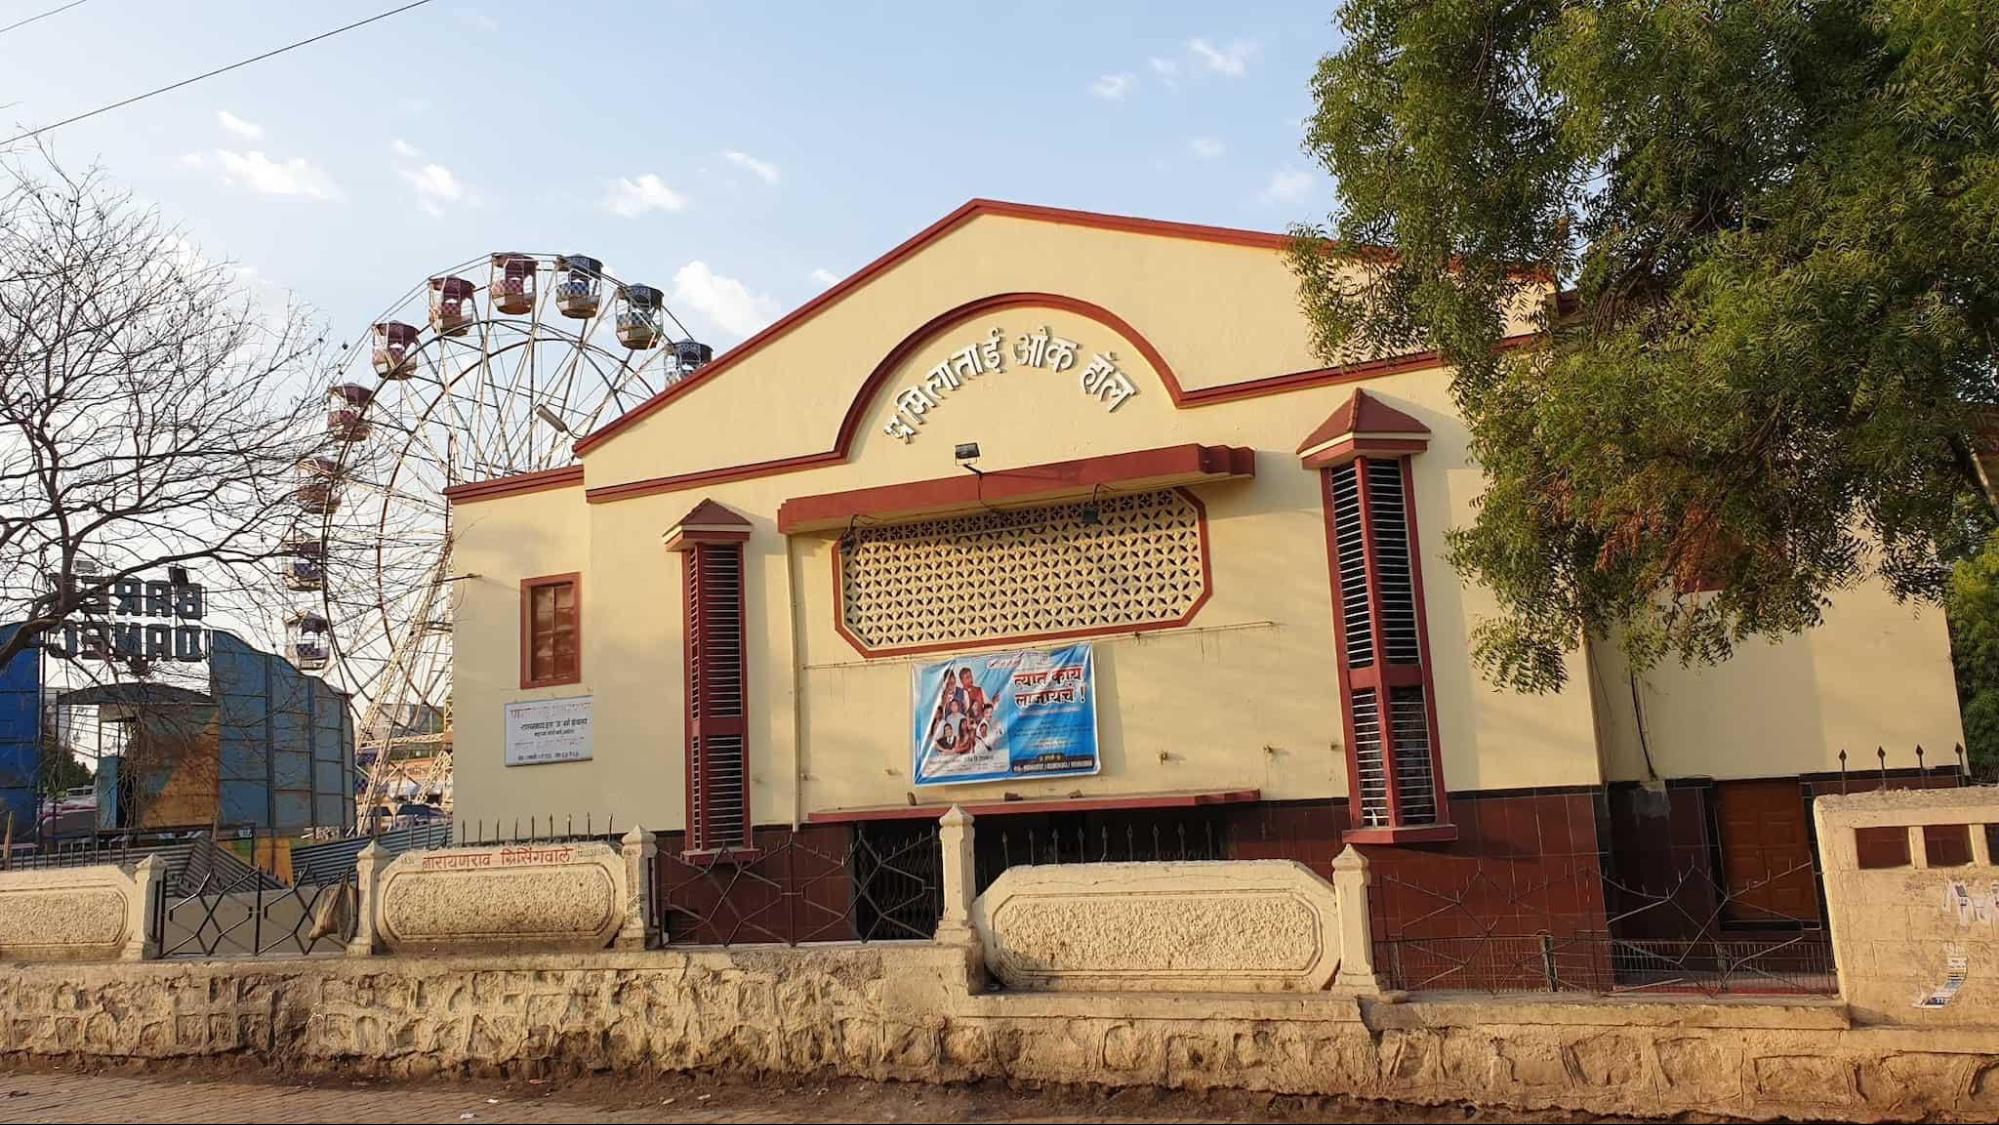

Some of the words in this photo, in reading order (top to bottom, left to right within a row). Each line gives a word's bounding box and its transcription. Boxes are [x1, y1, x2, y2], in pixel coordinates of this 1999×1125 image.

[1080, 351, 1138, 412] हॉल
[1013, 671, 1048, 687] त्यात
[1051, 666, 1083, 685] काय
